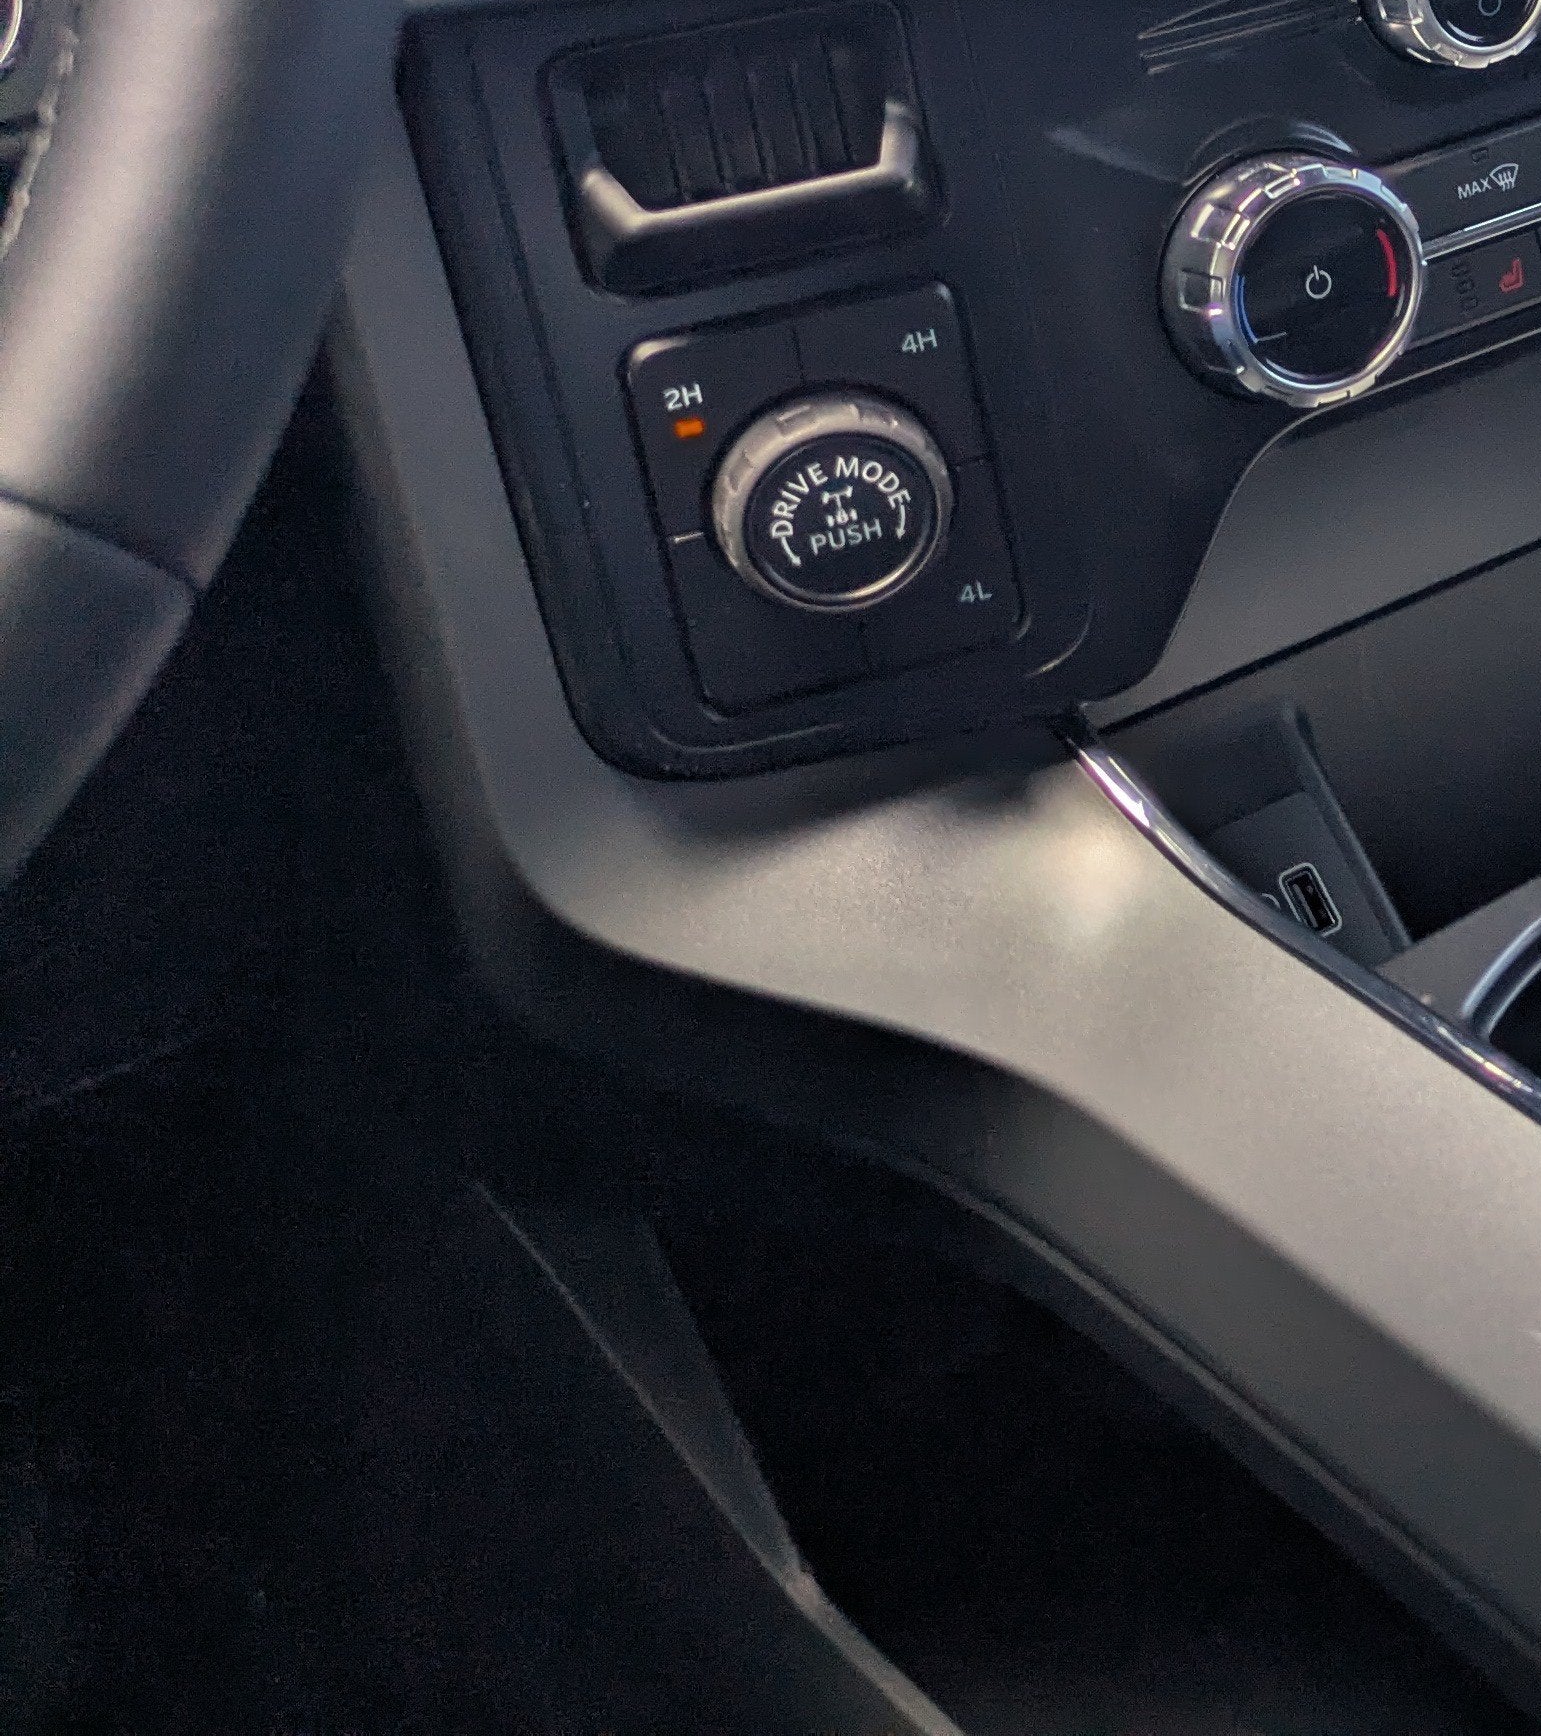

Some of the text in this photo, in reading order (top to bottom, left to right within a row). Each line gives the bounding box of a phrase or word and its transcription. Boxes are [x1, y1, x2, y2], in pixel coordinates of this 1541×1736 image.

[1457, 178, 1493, 201] MAX
[901, 328, 939, 354] 4H
[663, 383, 704, 411] 2H
[769, 455, 912, 540] DRIVE MODE
[809, 518, 884, 555] PUSH
[958, 580, 993, 604] 4L
